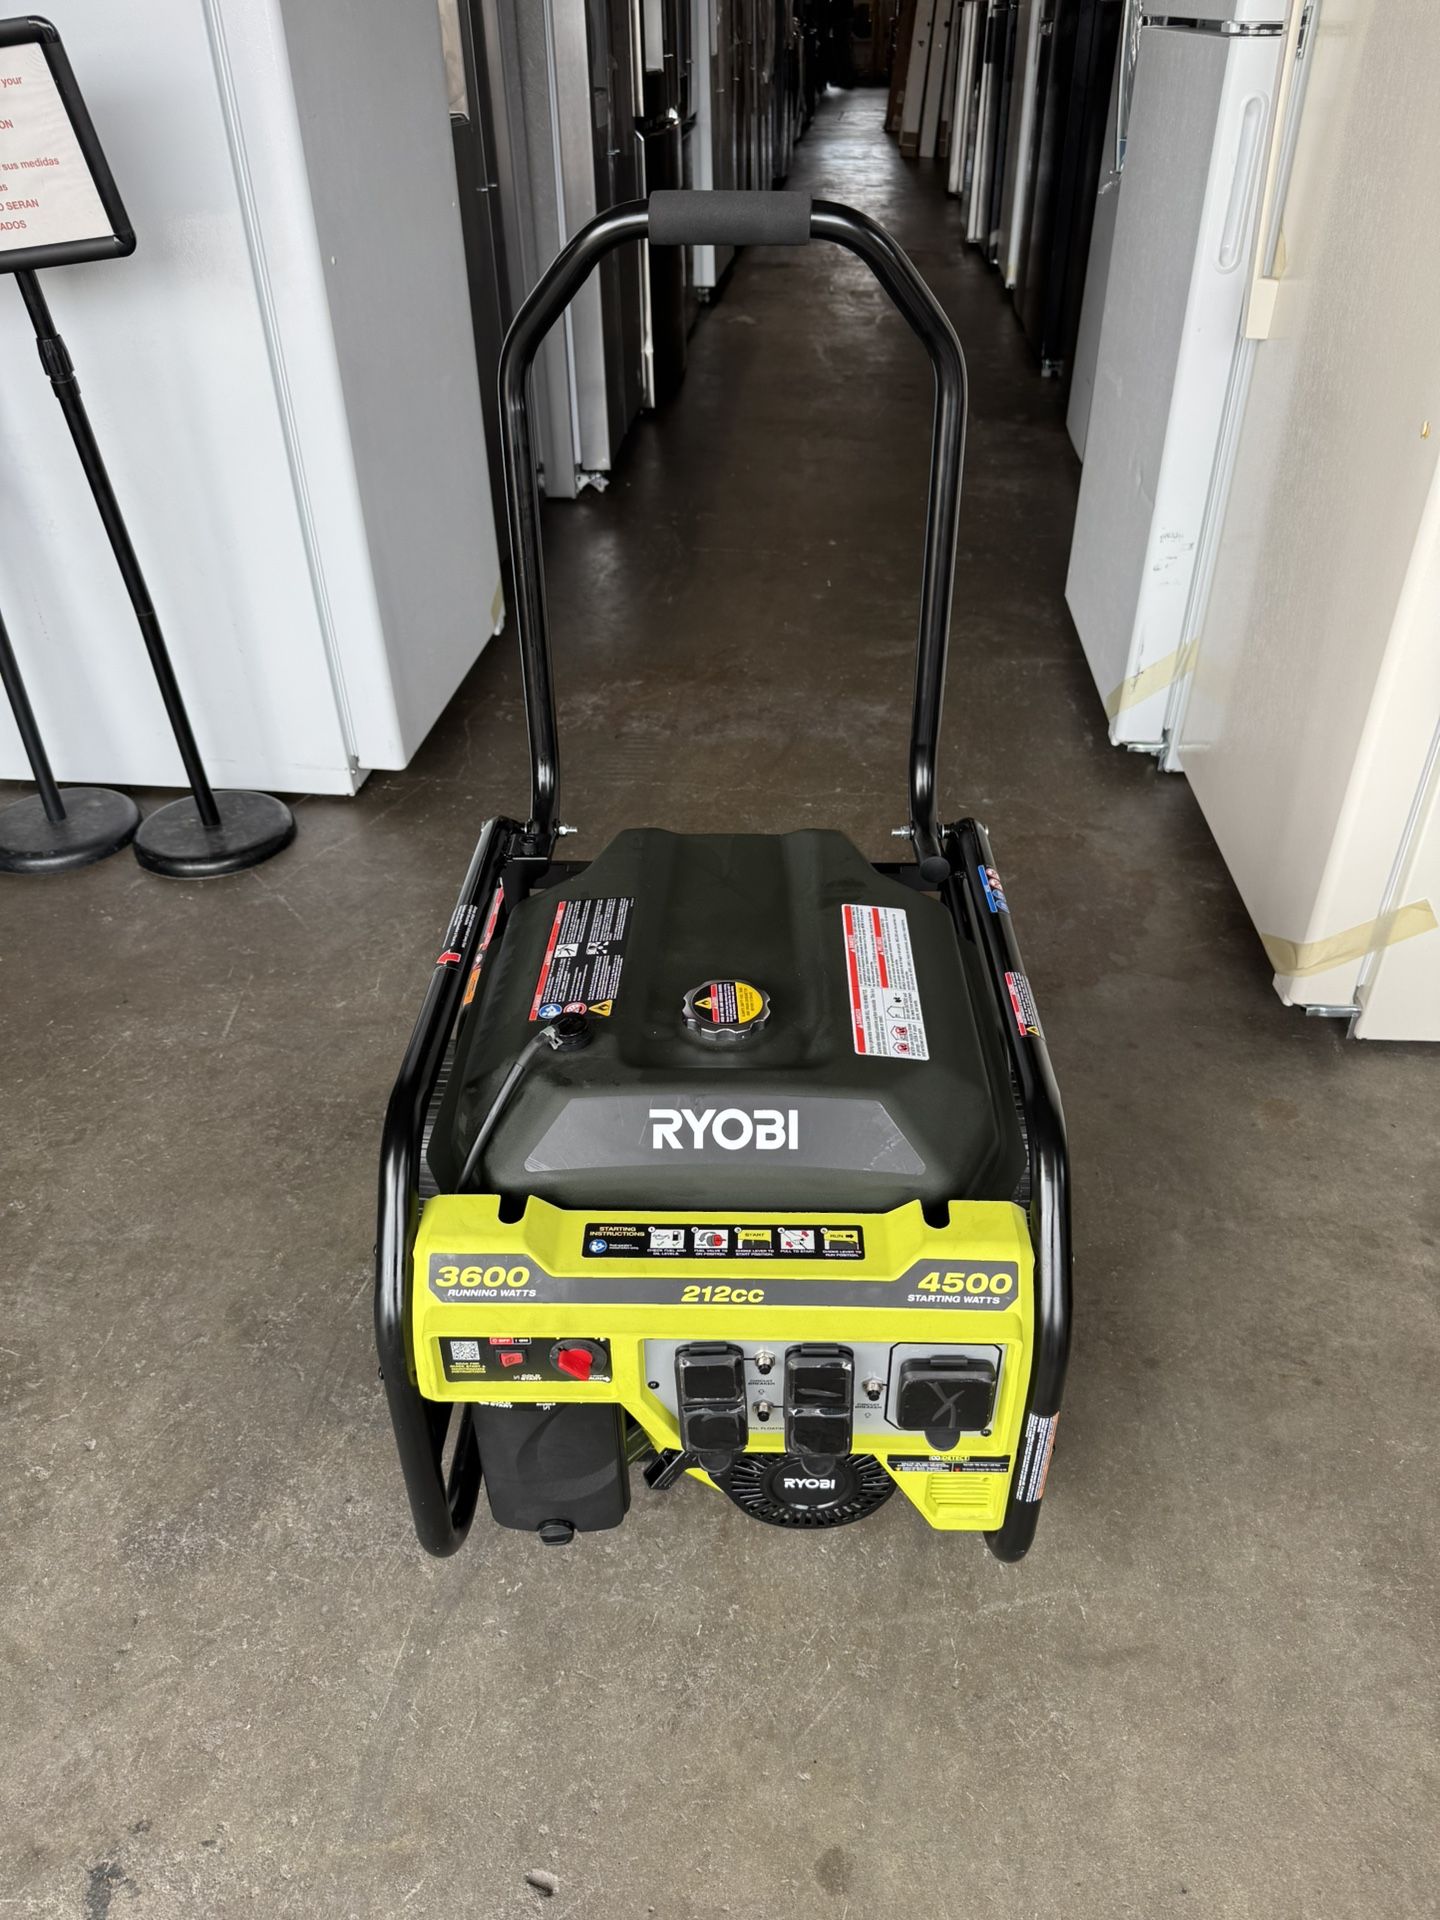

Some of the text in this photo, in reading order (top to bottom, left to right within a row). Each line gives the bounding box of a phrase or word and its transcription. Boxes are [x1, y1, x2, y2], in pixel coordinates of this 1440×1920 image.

[0, 77, 22, 88] your
[1, 162, 19, 171] sus
[19, 157, 60, 169] medidas
[5, 198, 40, 211] SERAN
[649, 1108, 799, 1151] RYOBI
[434, 1265, 531, 1288] 3600
[917, 1272, 1013, 1294] 4500
[447, 1288, 537, 1298] RUNNING WATTS
[680, 1285, 765, 1303] 212cc
[907, 1294, 1001, 1305] STARTING WATTS
[783, 1477, 836, 1490] RYOBI
